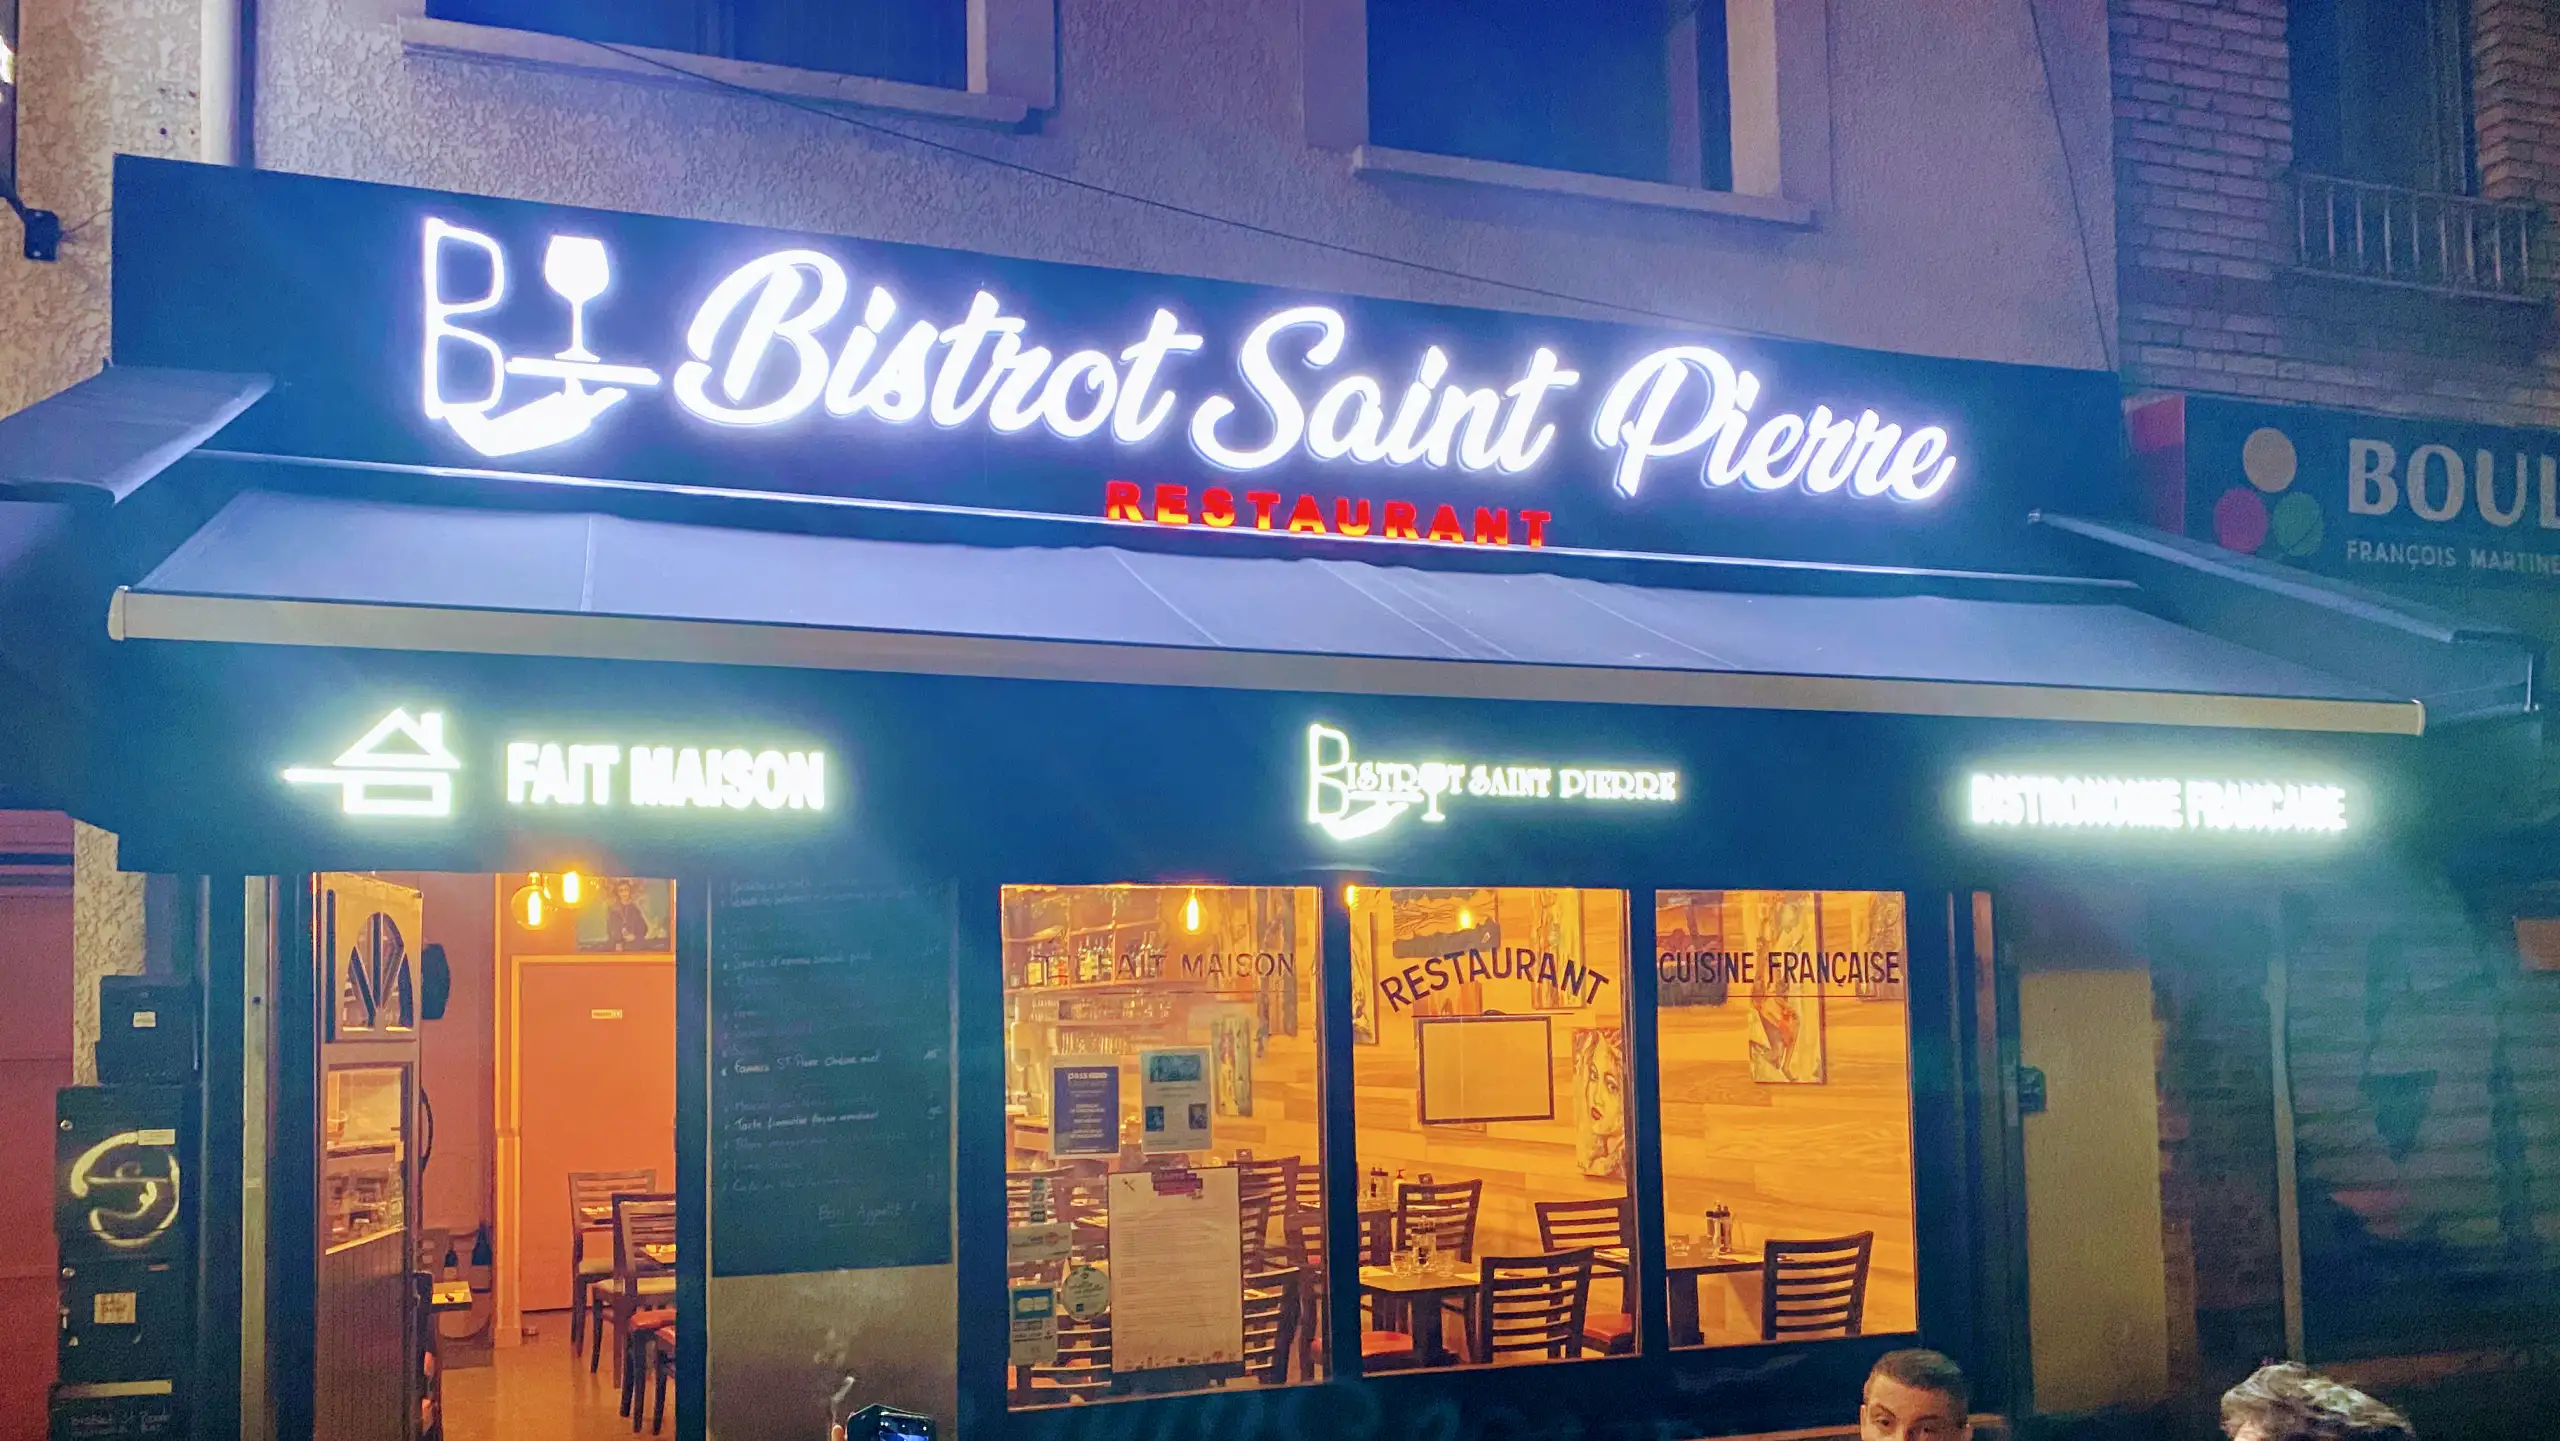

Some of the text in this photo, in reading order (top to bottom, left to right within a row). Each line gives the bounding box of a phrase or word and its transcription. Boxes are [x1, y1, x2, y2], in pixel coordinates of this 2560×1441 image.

[673, 249, 1957, 501] Bistrot Saint Pierre
[1105, 480, 1552, 549] RESTAURANT
[2349, 438, 2560, 530] BOUL
[2347, 540, 2457, 571] FRANÇOIS
[507, 741, 825, 810] FAIT MAISON
[1468, 764, 1553, 798] SAINT
[1558, 768, 1677, 802] PIERRE
[1181, 952, 1294, 979] MAISON
[1380, 947, 1609, 1012] RESTAURANT
[1659, 951, 1900, 987] CUISINE FRANÇAISE
